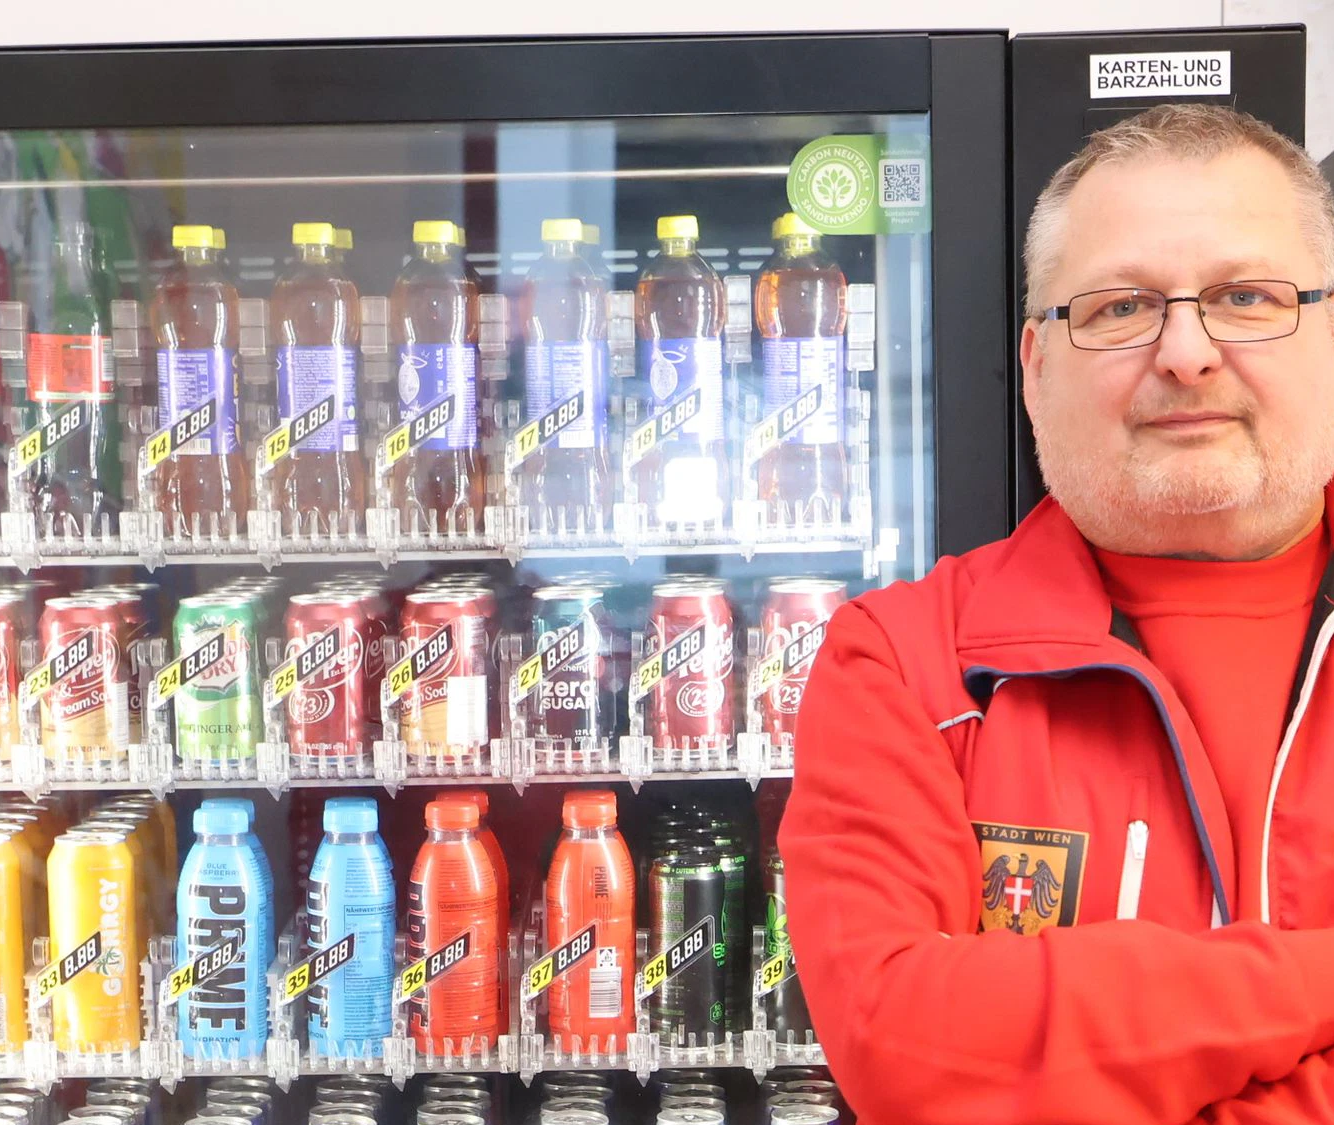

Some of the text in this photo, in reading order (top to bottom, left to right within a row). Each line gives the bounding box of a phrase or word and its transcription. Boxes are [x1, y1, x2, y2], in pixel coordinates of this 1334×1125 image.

[1099, 59, 1220, 73] KARTEN- UND
[1098, 74, 1222, 88] BARZAHLUNG
[798, 148, 871, 182] CARBON NEUTRAL
[801, 198, 868, 224] SANDENVENDO
[150, 406, 211, 458] 14 8.88
[269, 404, 330, 457] 15 8.88
[388, 401, 450, 456] 16 8.88
[518, 430, 537, 451] 17
[20, 437, 39, 460] 13
[158, 639, 219, 694] 24 8.88
[275, 636, 335, 693] 25 8.88
[391, 634, 447, 692] 26 8.88
[521, 631, 579, 688] 27 8.88
[30, 673, 49, 695] 23
[641, 663, 660, 686] 28
[543, 681, 595, 697] zero
[982, 827, 1071, 844] STADT WIEN
[595, 866, 609, 899] PRIME
[404, 939, 464, 992] 36 8.88
[532, 933, 590, 986] 37 8.88
[645, 931, 703, 983] 38 8.88
[41, 973, 58, 995] 33
[172, 970, 191, 994] 34
[287, 971, 306, 993] 35
[764, 961, 782, 984] 39
